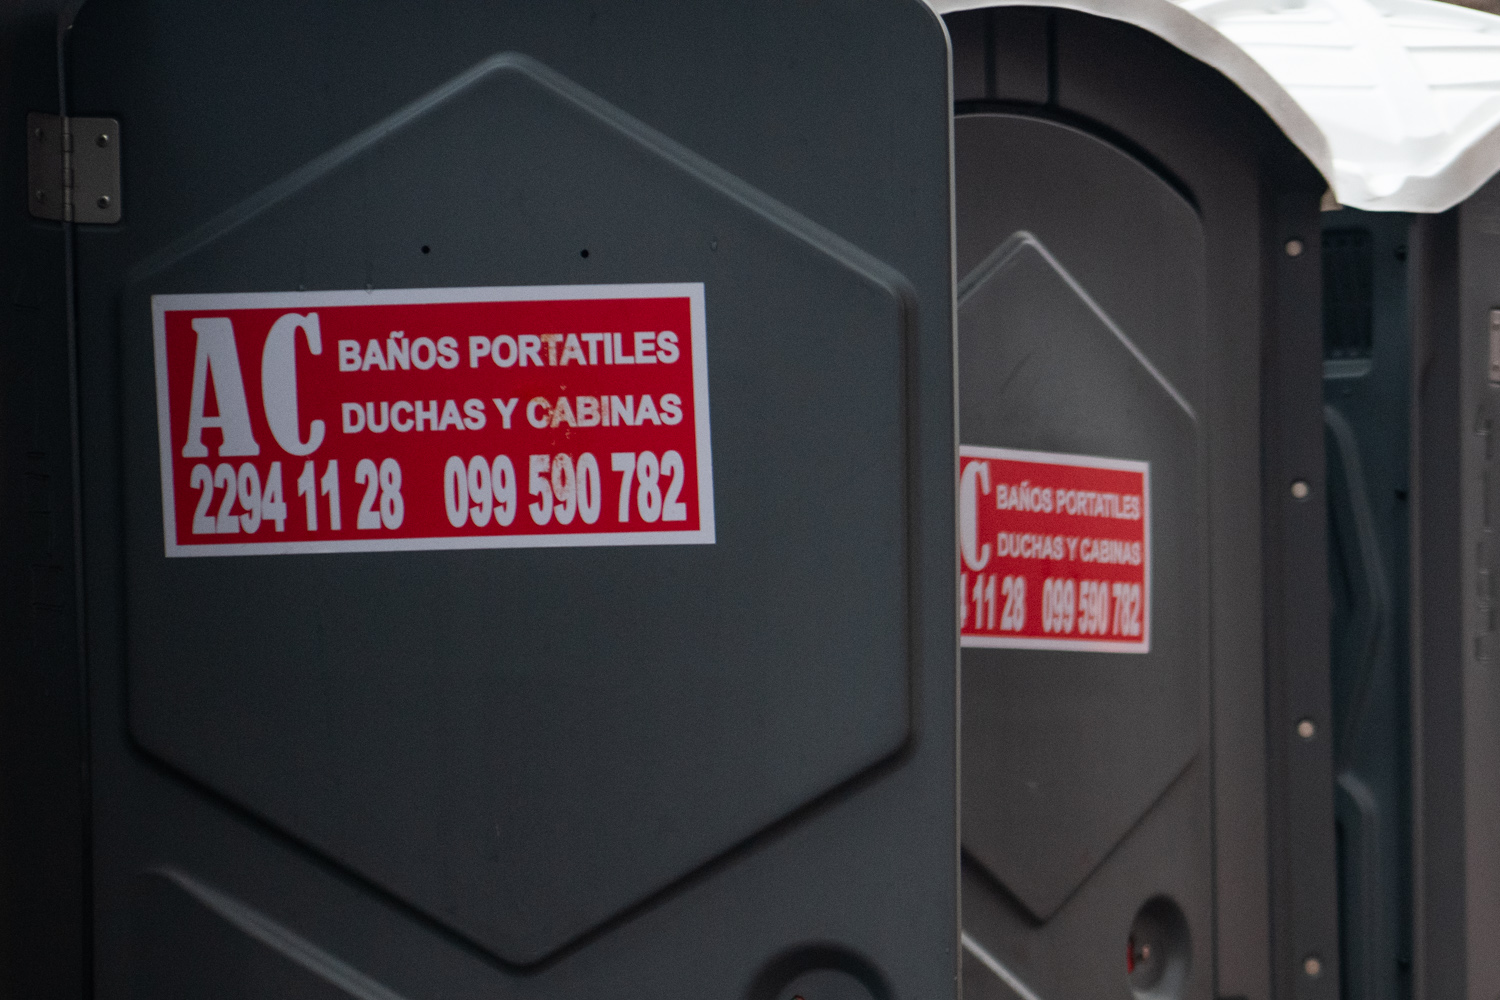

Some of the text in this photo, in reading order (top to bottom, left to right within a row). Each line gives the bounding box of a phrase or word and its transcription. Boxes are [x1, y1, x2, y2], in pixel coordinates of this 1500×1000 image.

[338, 330, 680, 372] BAÑOS PORTATILES
[182, 312, 326, 458] AC
[341, 394, 684, 434] DUCHAS Y CABINAS
[190, 450, 687, 535] 2294 11 28 099 590 782
[996, 480, 1141, 520] BAÑOS PORTATILES
[997, 532, 1141, 566] DUCHAS Y CABINAS
[972, 573, 996, 630] 11
[1000, 576, 1025, 631] 28
[1042, 577, 1076, 634] 099
[1078, 580, 1109, 635] 590
[1112, 582, 1142, 637] 782
